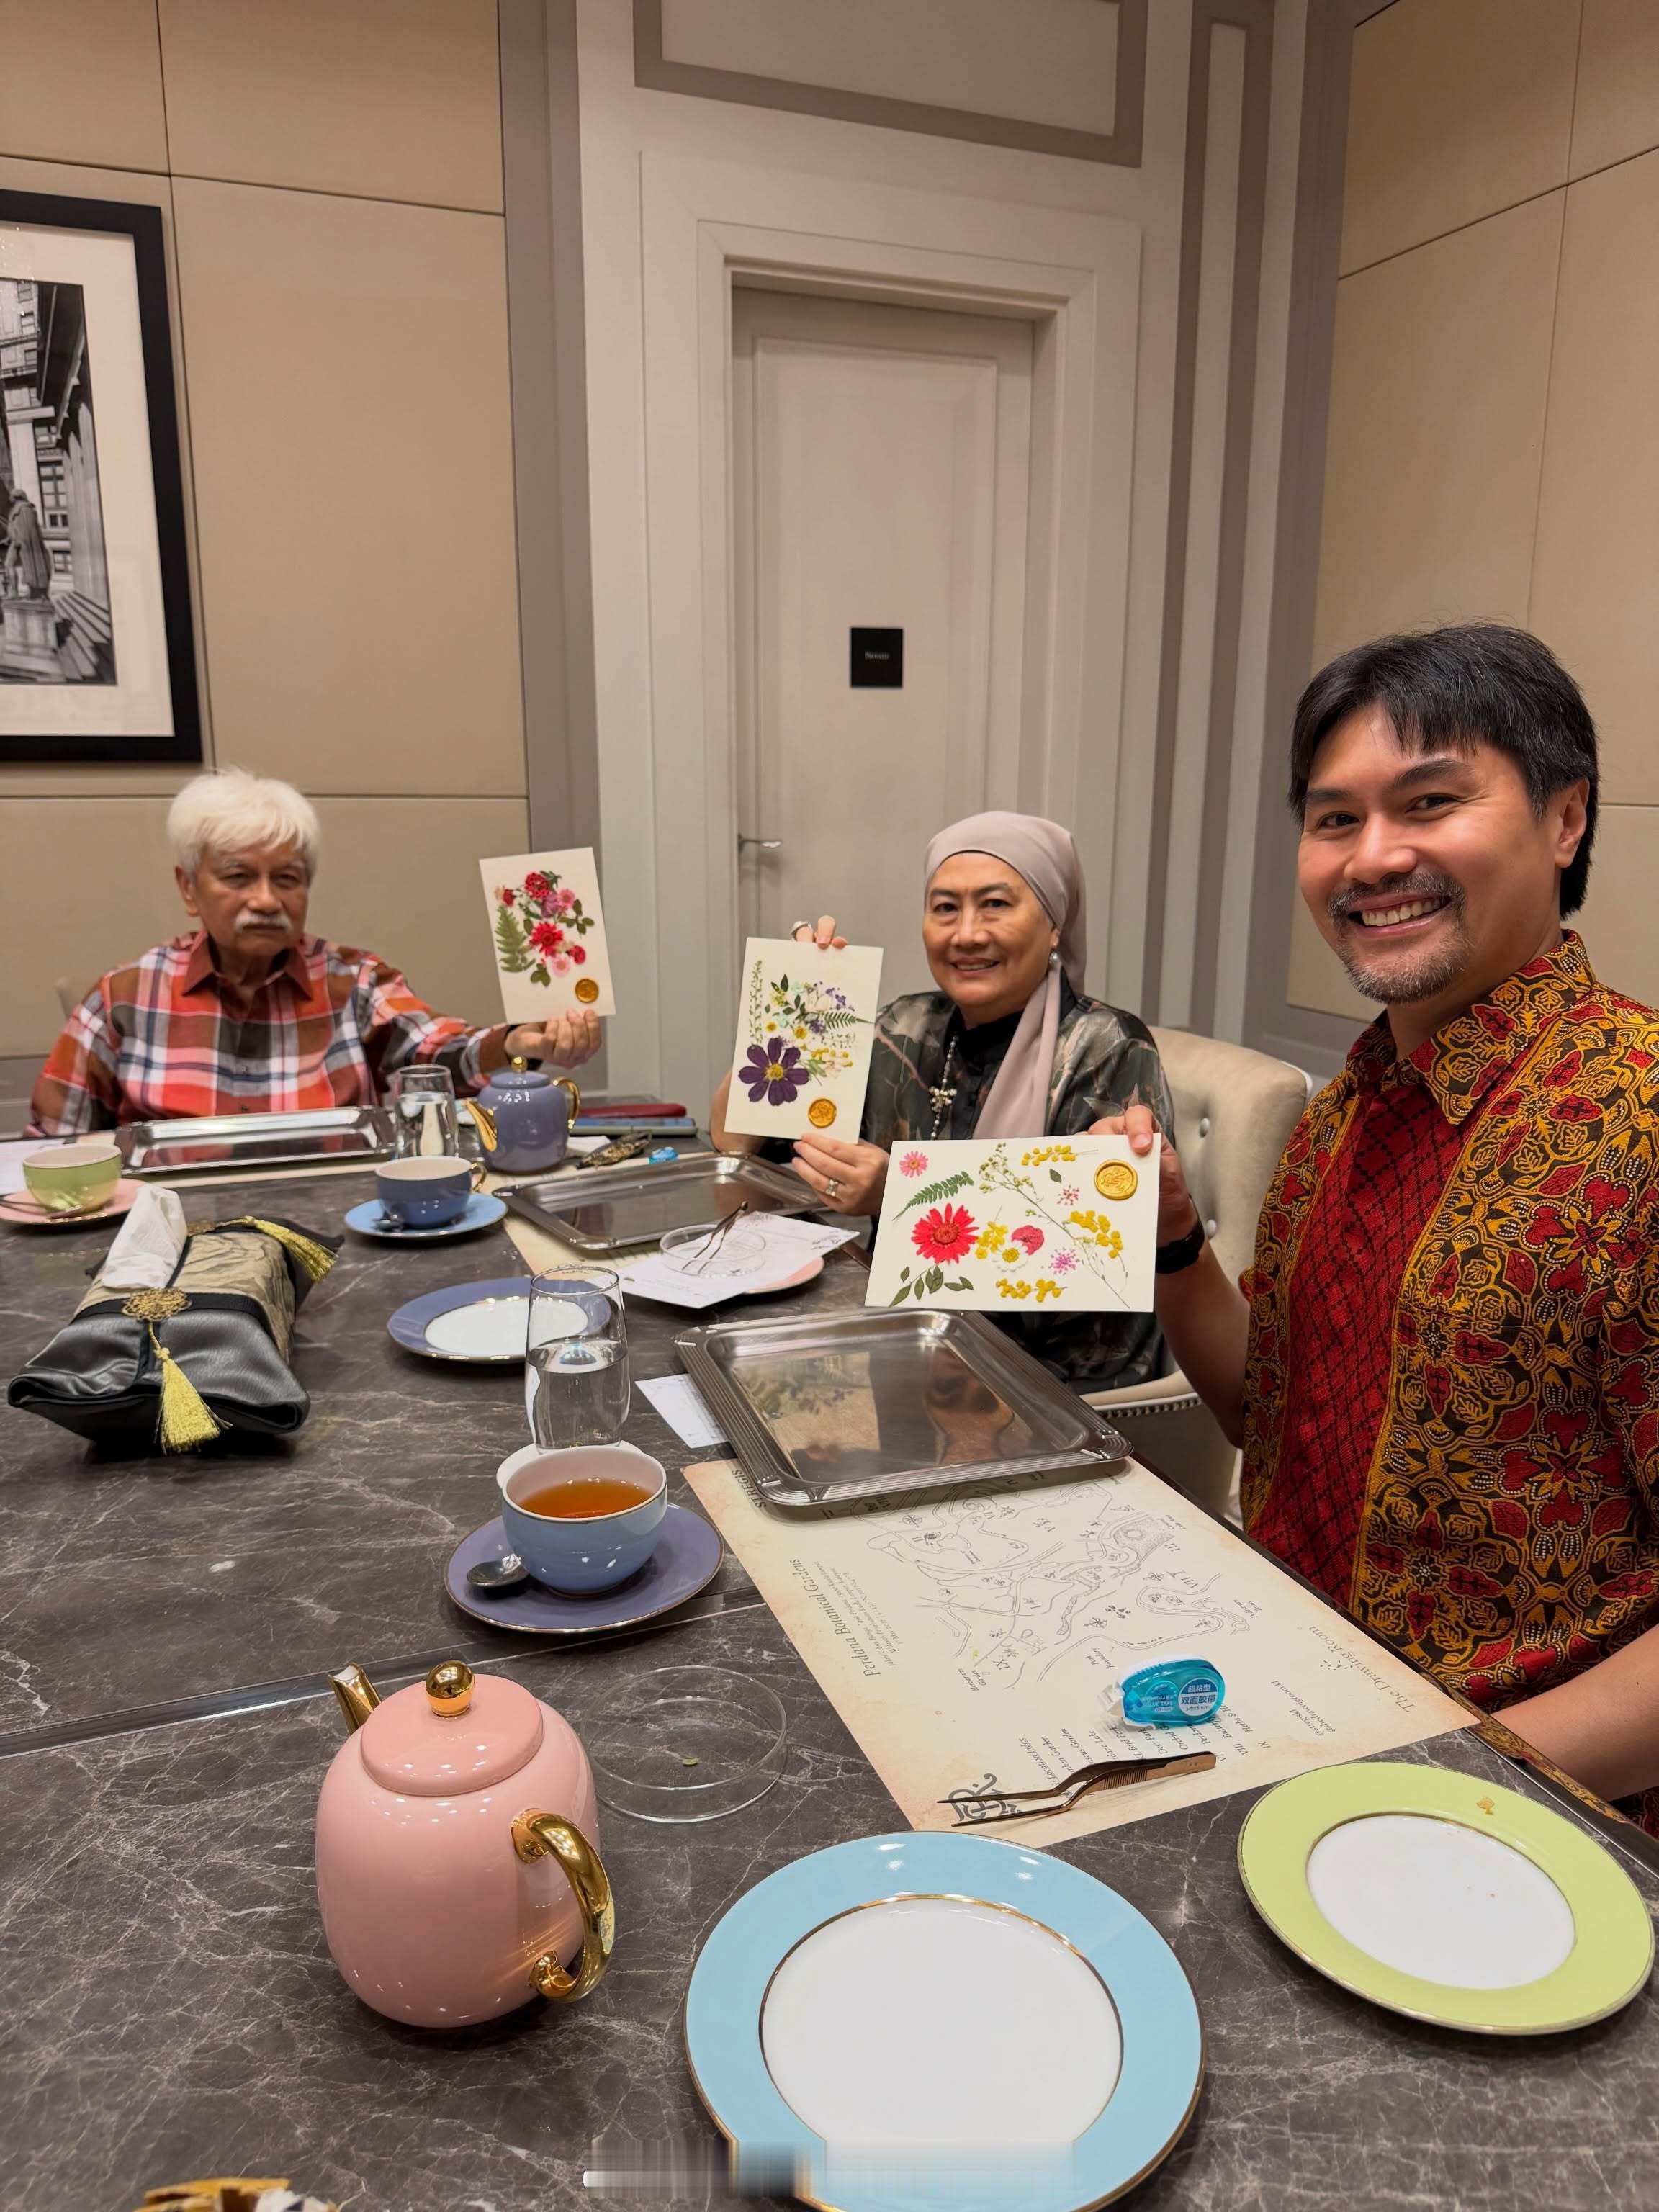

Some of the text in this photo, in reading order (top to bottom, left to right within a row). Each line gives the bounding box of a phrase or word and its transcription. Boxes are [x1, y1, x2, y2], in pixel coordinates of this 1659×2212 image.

[789, 1558, 882, 1677] Perdana Botanical Gardens
[1308, 1626, 1415, 1712] The Drawing Room
[1107, 1725, 1126, 1738] Park
[1234, 1717, 1254, 1732] Herbs
[1018, 1737, 1036, 1754] Index
[1060, 1727, 1080, 1748] Garden
[1088, 1730, 1104, 1743] Lake
[1120, 1739, 1138, 1751] Bird
[1136, 1727, 1169, 1755] Deer Park
[1164, 1731, 1189, 1750] Orchid
[1040, 1736, 1061, 1757] Garden
[1232, 1743, 1249, 1755] VIII
[1032, 1753, 1058, 1780] Location
